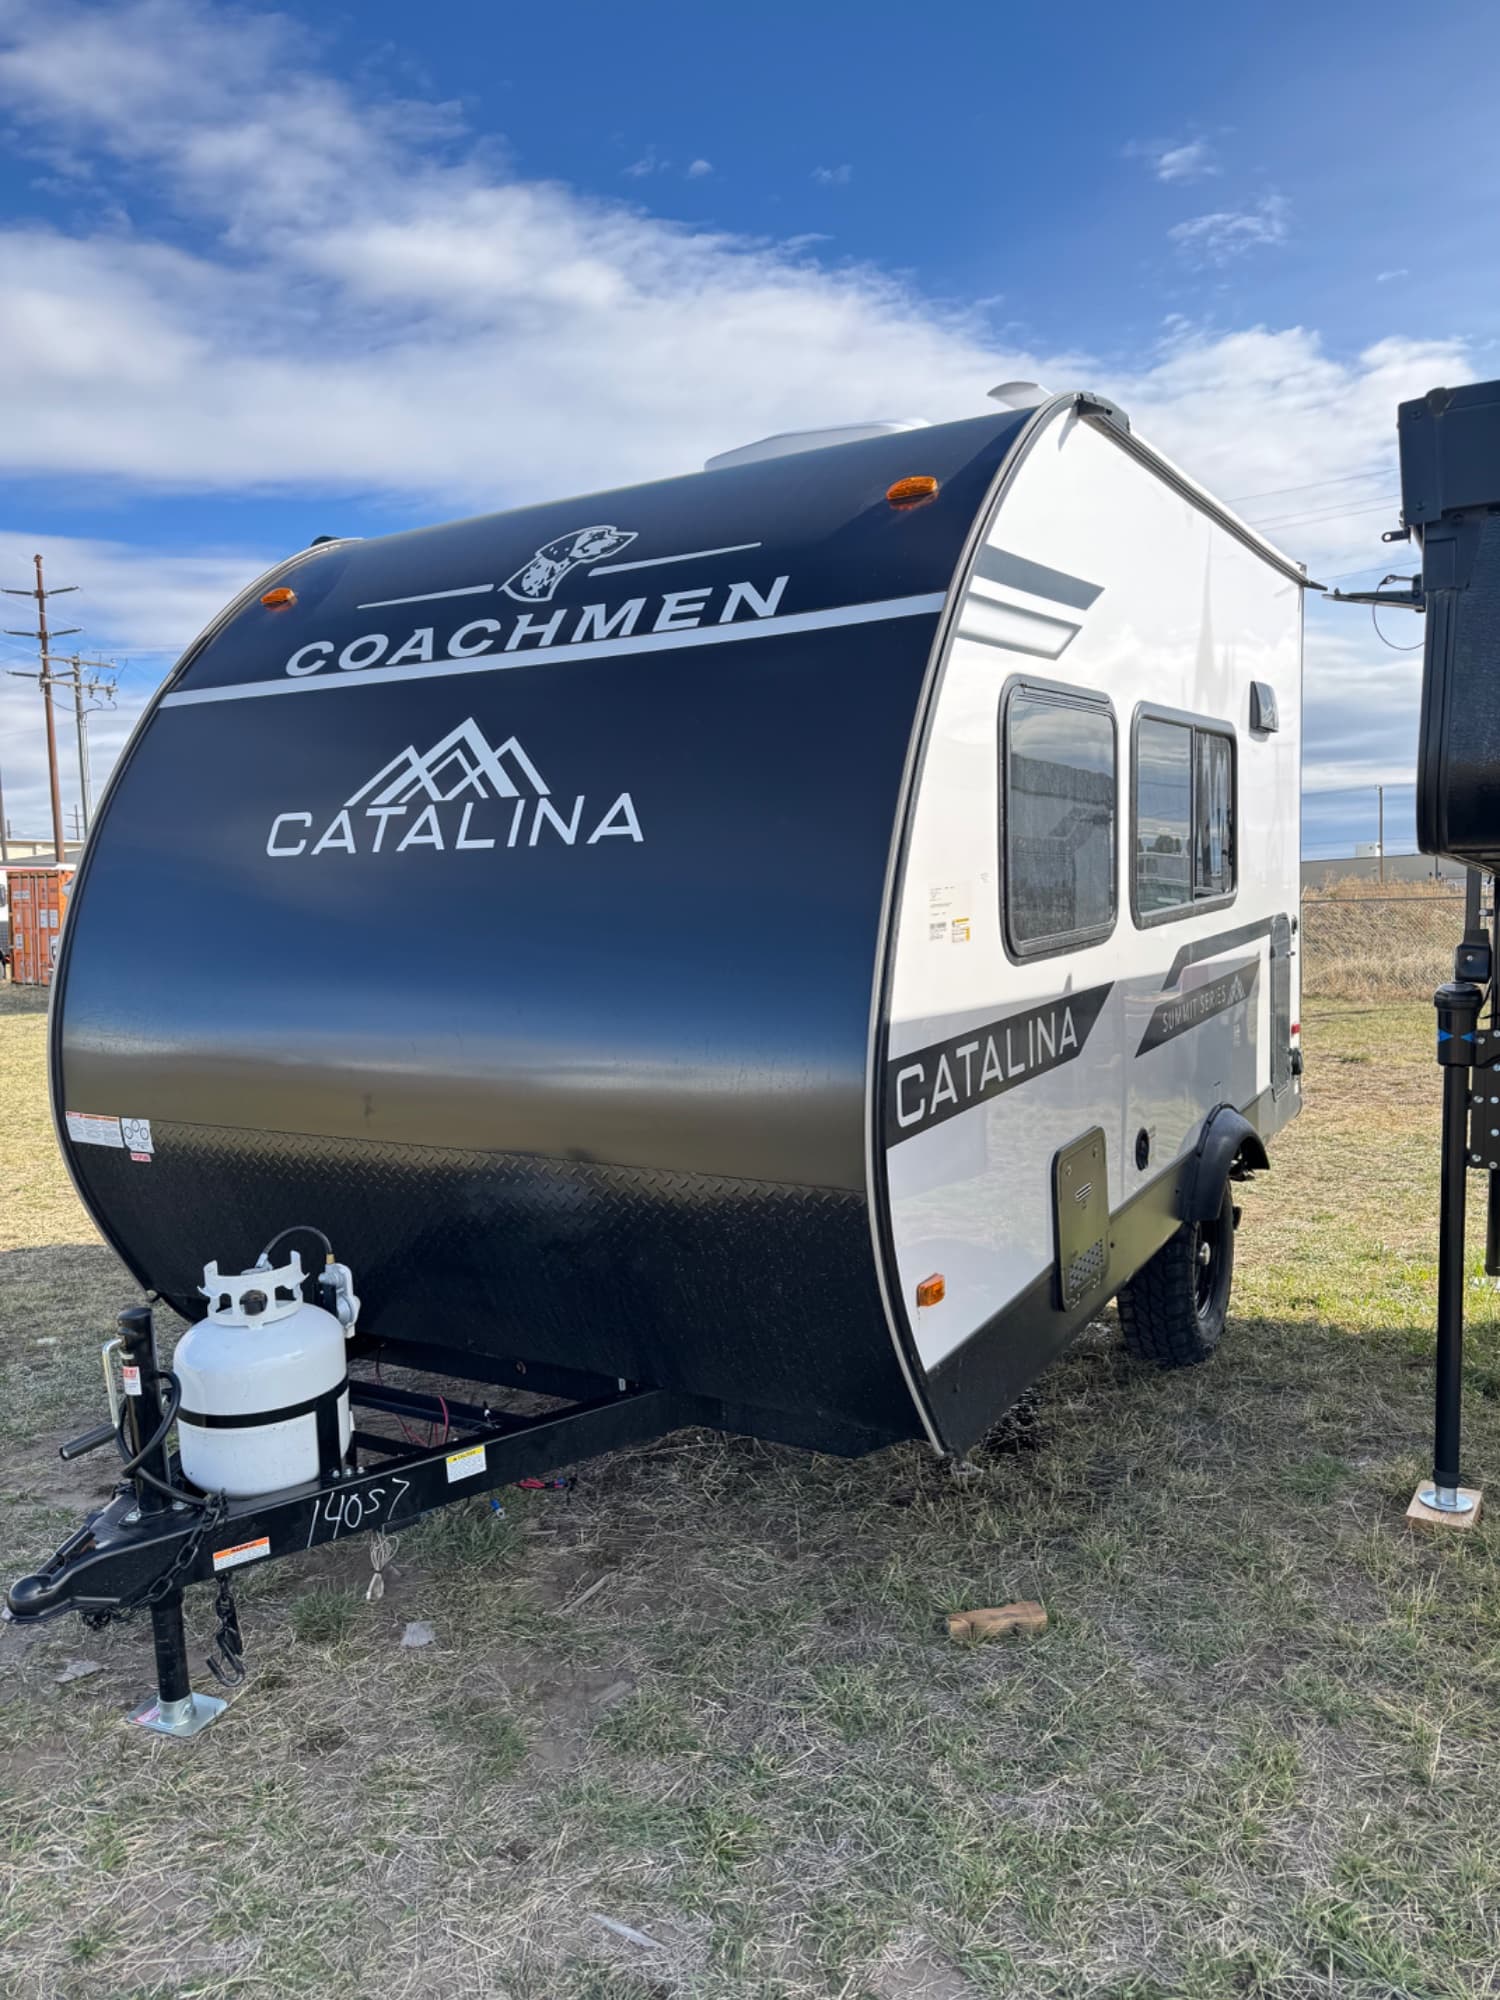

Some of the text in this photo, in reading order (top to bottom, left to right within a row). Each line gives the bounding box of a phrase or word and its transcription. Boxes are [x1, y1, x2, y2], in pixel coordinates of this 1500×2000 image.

[285, 575, 790, 677] COACHMEN
[266, 792, 644, 857] CATALINA
[1162, 984, 1227, 1033] SUMMIT SERIES
[896, 1006, 1078, 1128] CATALINA
